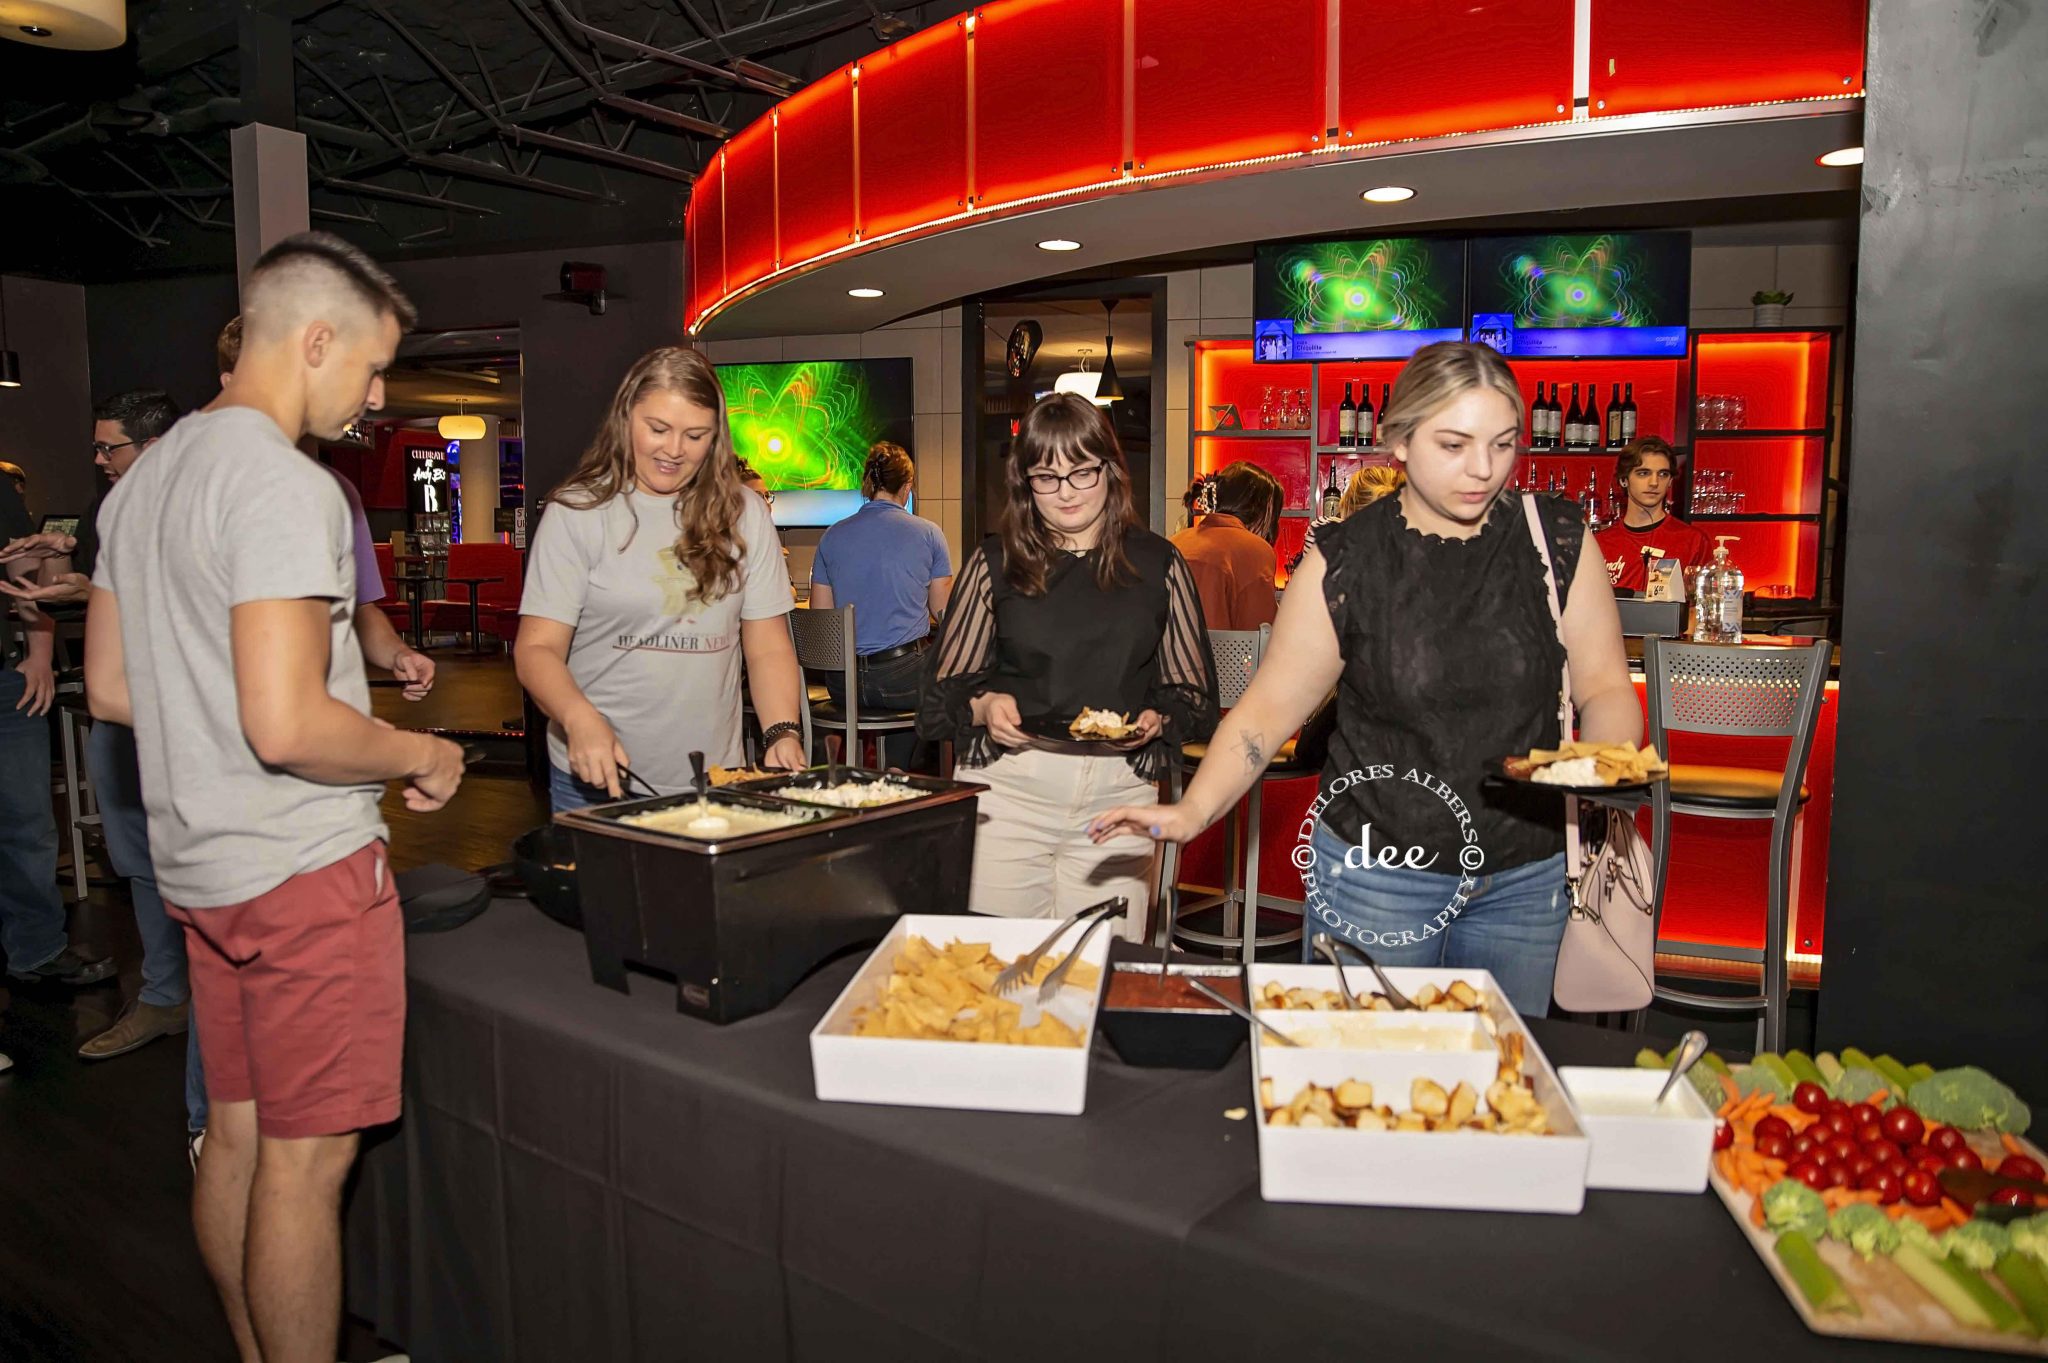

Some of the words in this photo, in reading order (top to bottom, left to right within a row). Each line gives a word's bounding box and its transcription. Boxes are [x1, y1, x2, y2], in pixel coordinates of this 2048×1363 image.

[411, 449, 446, 460] CELEBRATE
[413, 466, 432, 485] Andy
[1604, 555, 1626, 578] ndy
